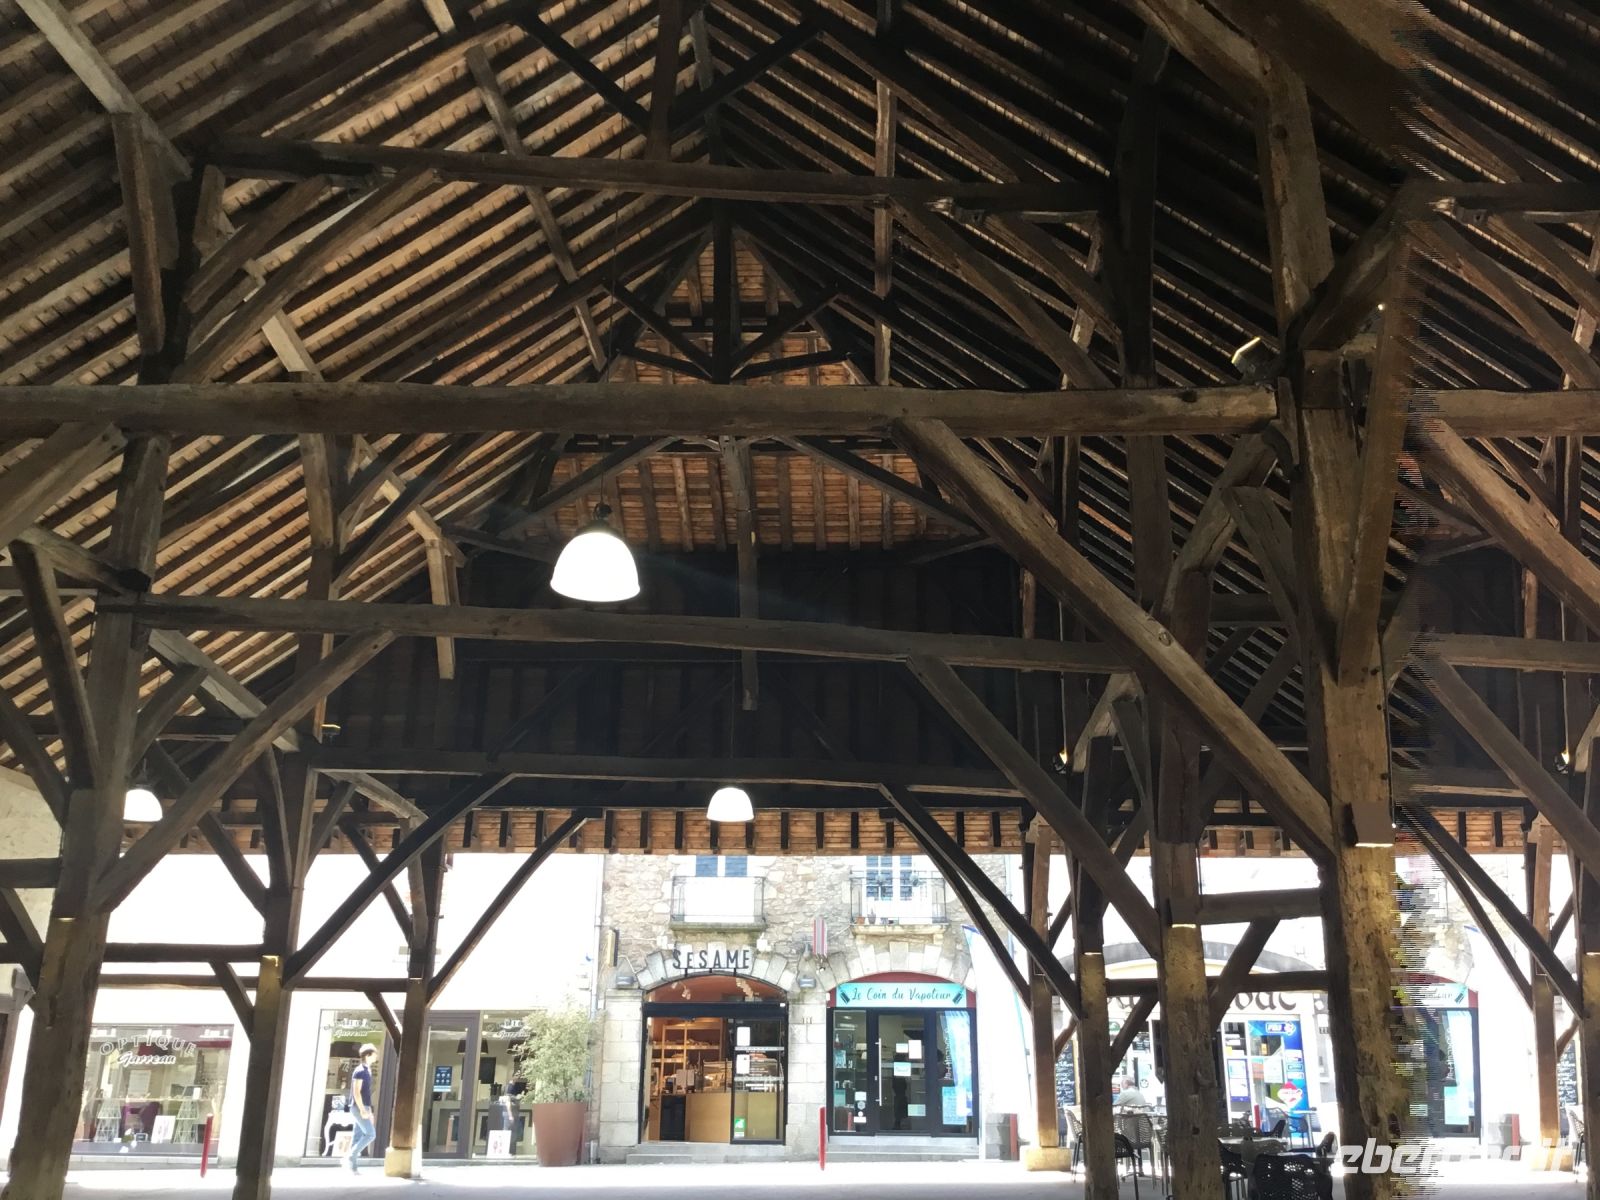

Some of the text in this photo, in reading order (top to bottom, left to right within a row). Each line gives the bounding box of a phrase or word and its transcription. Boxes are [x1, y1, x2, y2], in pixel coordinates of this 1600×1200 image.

[866, 987, 887, 1000] Coin
[892, 987, 904, 1000] du
[909, 987, 951, 1003] Vapoteur
[99, 1034, 197, 1057] OPTIQUE
[117, 1051, 177, 1066] Garreau
